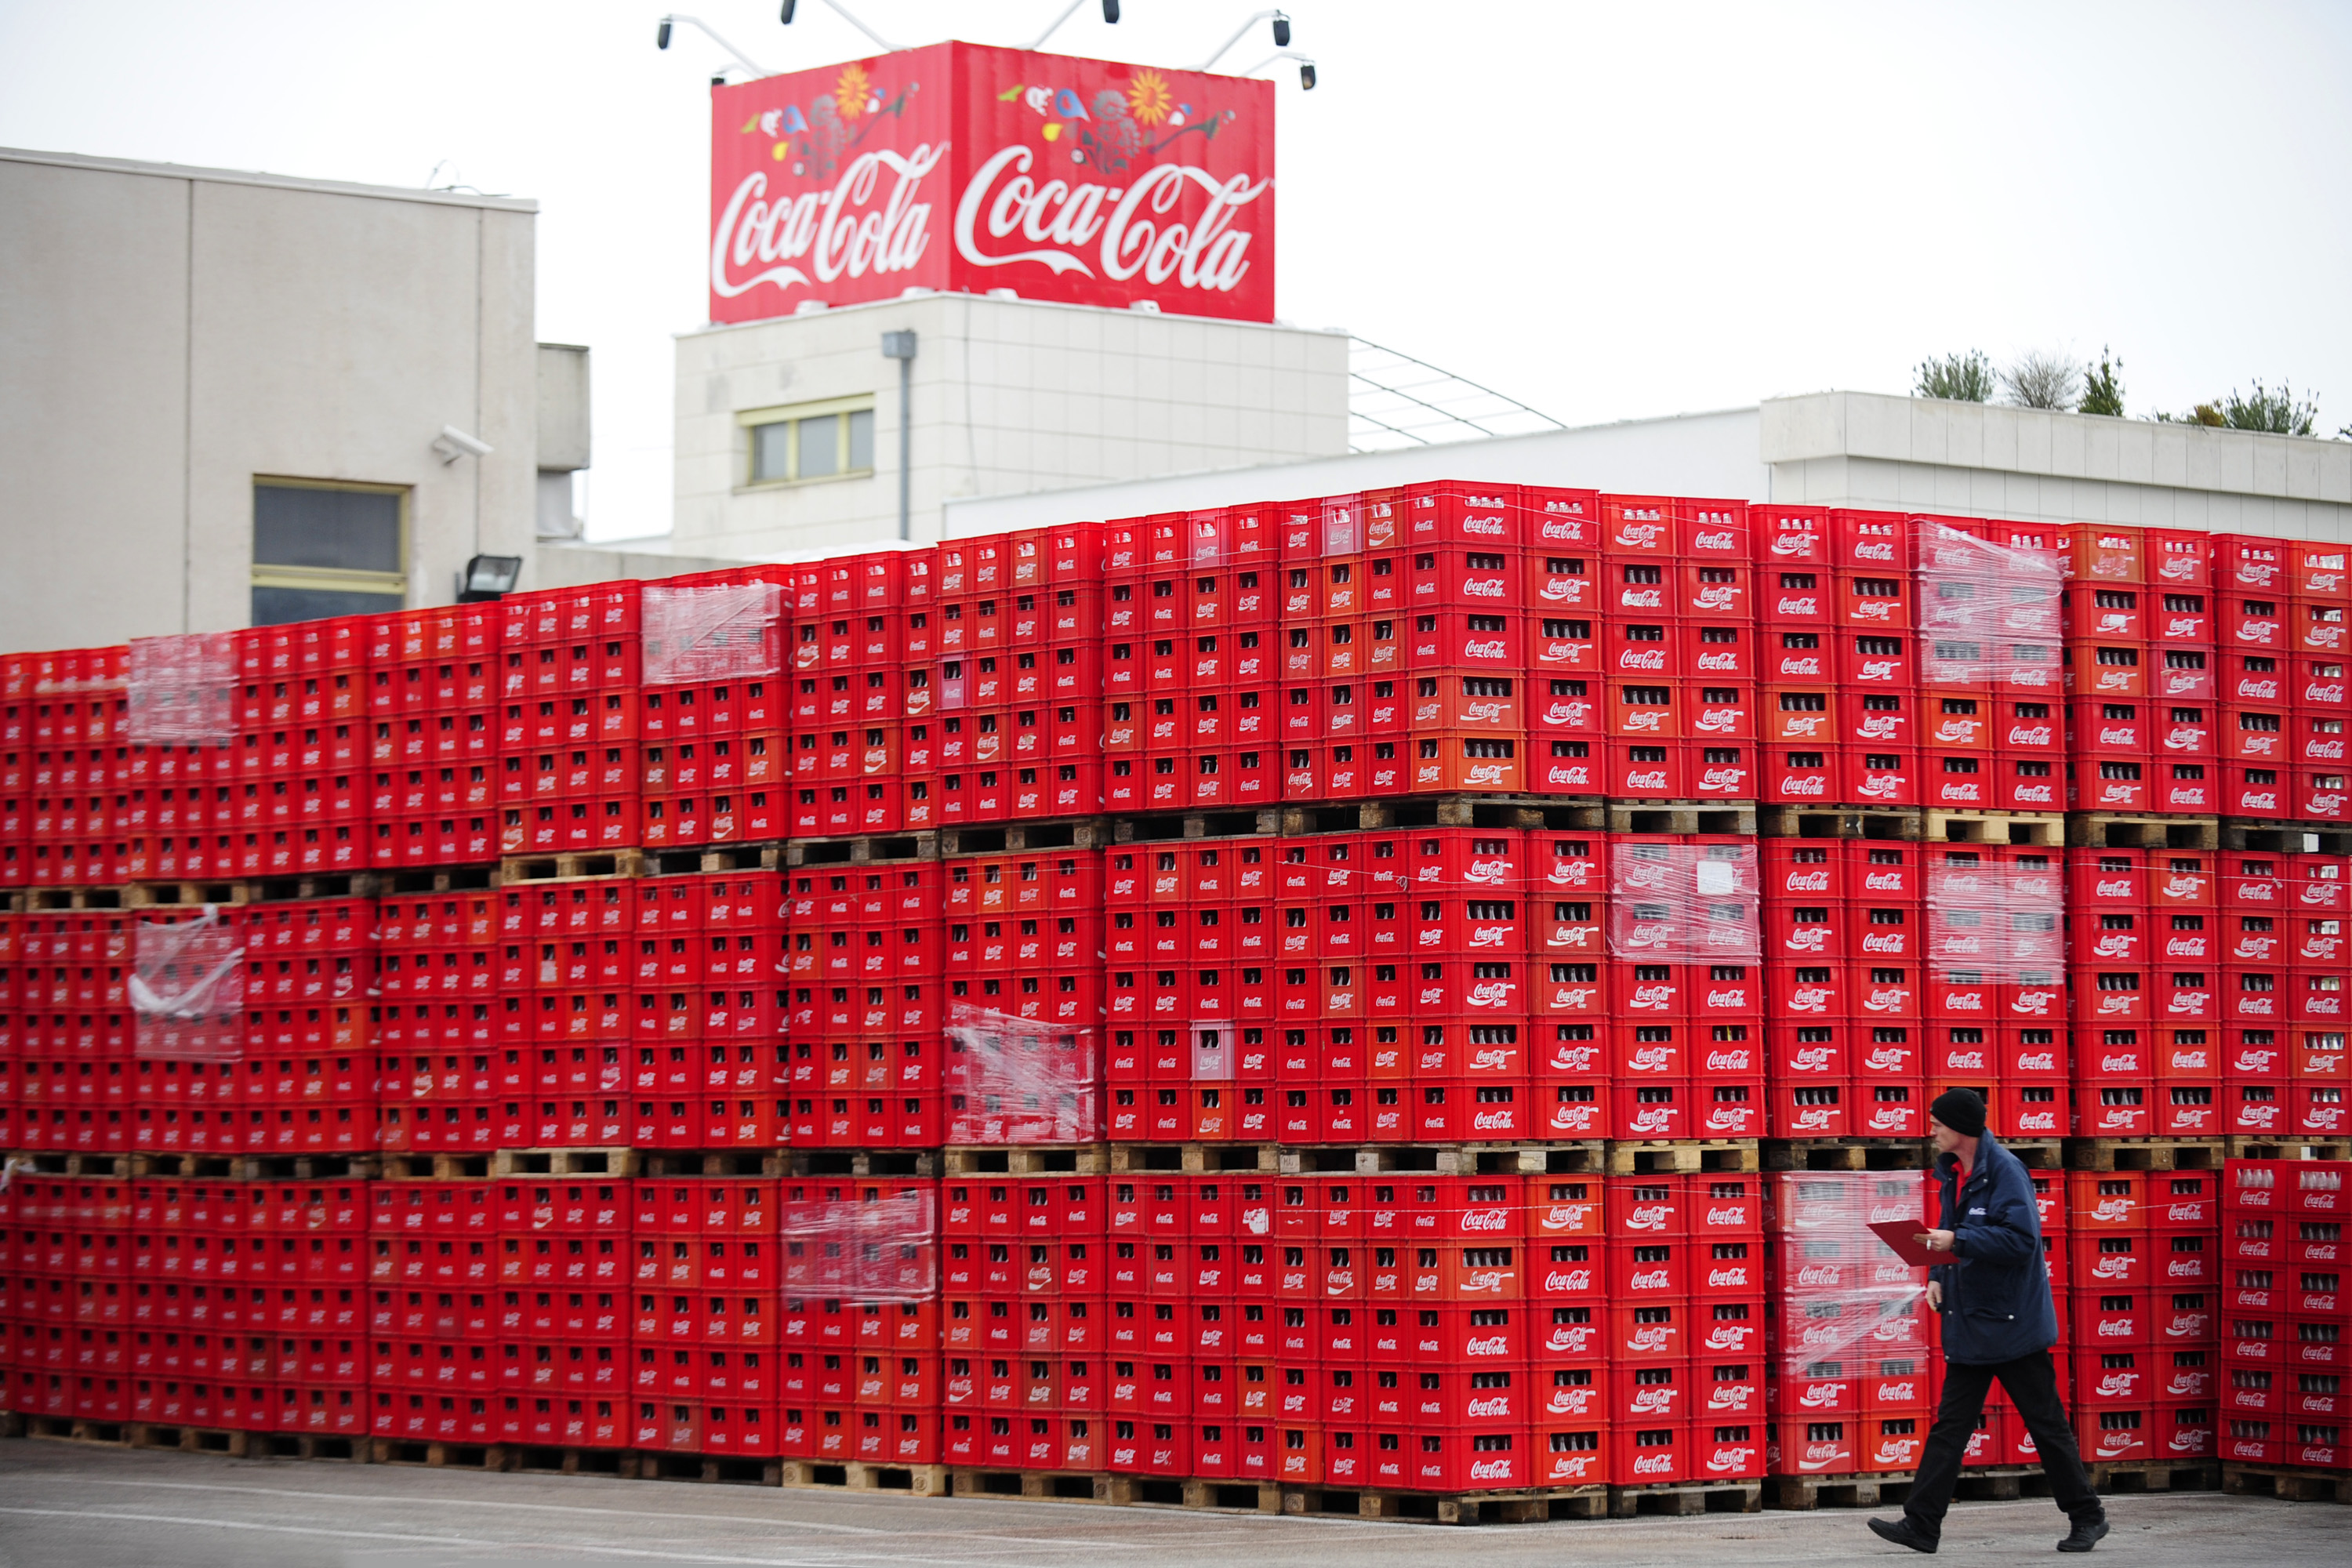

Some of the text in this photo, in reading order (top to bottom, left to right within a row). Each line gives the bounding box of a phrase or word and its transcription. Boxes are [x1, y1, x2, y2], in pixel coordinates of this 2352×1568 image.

[710, 142, 950, 298] Coca-Cola
[954, 144, 1273, 292] Coca-Cola
[1464, 516, 1504, 534] Coca-Cola
[1542, 519, 1582, 539] Coca-Cola
[1696, 532, 1734, 549] Coca-Cola
[1855, 542, 1894, 560] Coca-Cola
[1464, 578, 1505, 597] Coca-Cola
[1778, 597, 1817, 615] Coca-Cola
[1465, 640, 1506, 658] Coca-Cola
[1621, 649, 1666, 669] Coca-Cola
[1698, 652, 1738, 670] Coca-Cola
[1781, 658, 1820, 674] Coca-Cola
[2009, 726, 2051, 745] Coca-Cola
[1548, 766, 1588, 784] Coca-Cola
[1627, 771, 1668, 788] Coca-Cola
[1781, 776, 1825, 794] Coca-Cola
[1941, 783, 1980, 800] Coca-Cola
[2014, 785, 2053, 802] Coca-Cola
[1787, 872, 1829, 891] Coca-Cola
[1866, 873, 1903, 890] Coca-Cola
[1863, 933, 1905, 953] Coca-Cola
[1708, 990, 1746, 1007] Coca-Cola
[1946, 993, 1983, 1009] Coca-Cola
[1707, 1050, 1750, 1069] Coca-Cola
[1947, 1051, 1984, 1069] Coca-Cola
[2018, 1053, 2054, 1069] Coca-Cola
[1475, 1111, 1514, 1129] Coca-Cola
[2020, 1112, 2056, 1129] Coca-Cola
[1461, 1210, 1509, 1231] Coca-Cola
[1708, 1207, 1745, 1225] Coca-Cola
[1545, 1270, 1591, 1291] Coca-Cola
[1632, 1270, 1670, 1290] Coca-Cola
[1709, 1268, 1748, 1287] Coca-Cola
[1467, 1337, 1508, 1356] Coca-Cola
[1878, 1383, 1915, 1400] Coca-Cola
[1468, 1397, 1510, 1417] Coca-Cola
[1471, 1460, 1512, 1479] Coca-Cola
[1634, 1454, 1673, 1474] Coca-Cola
